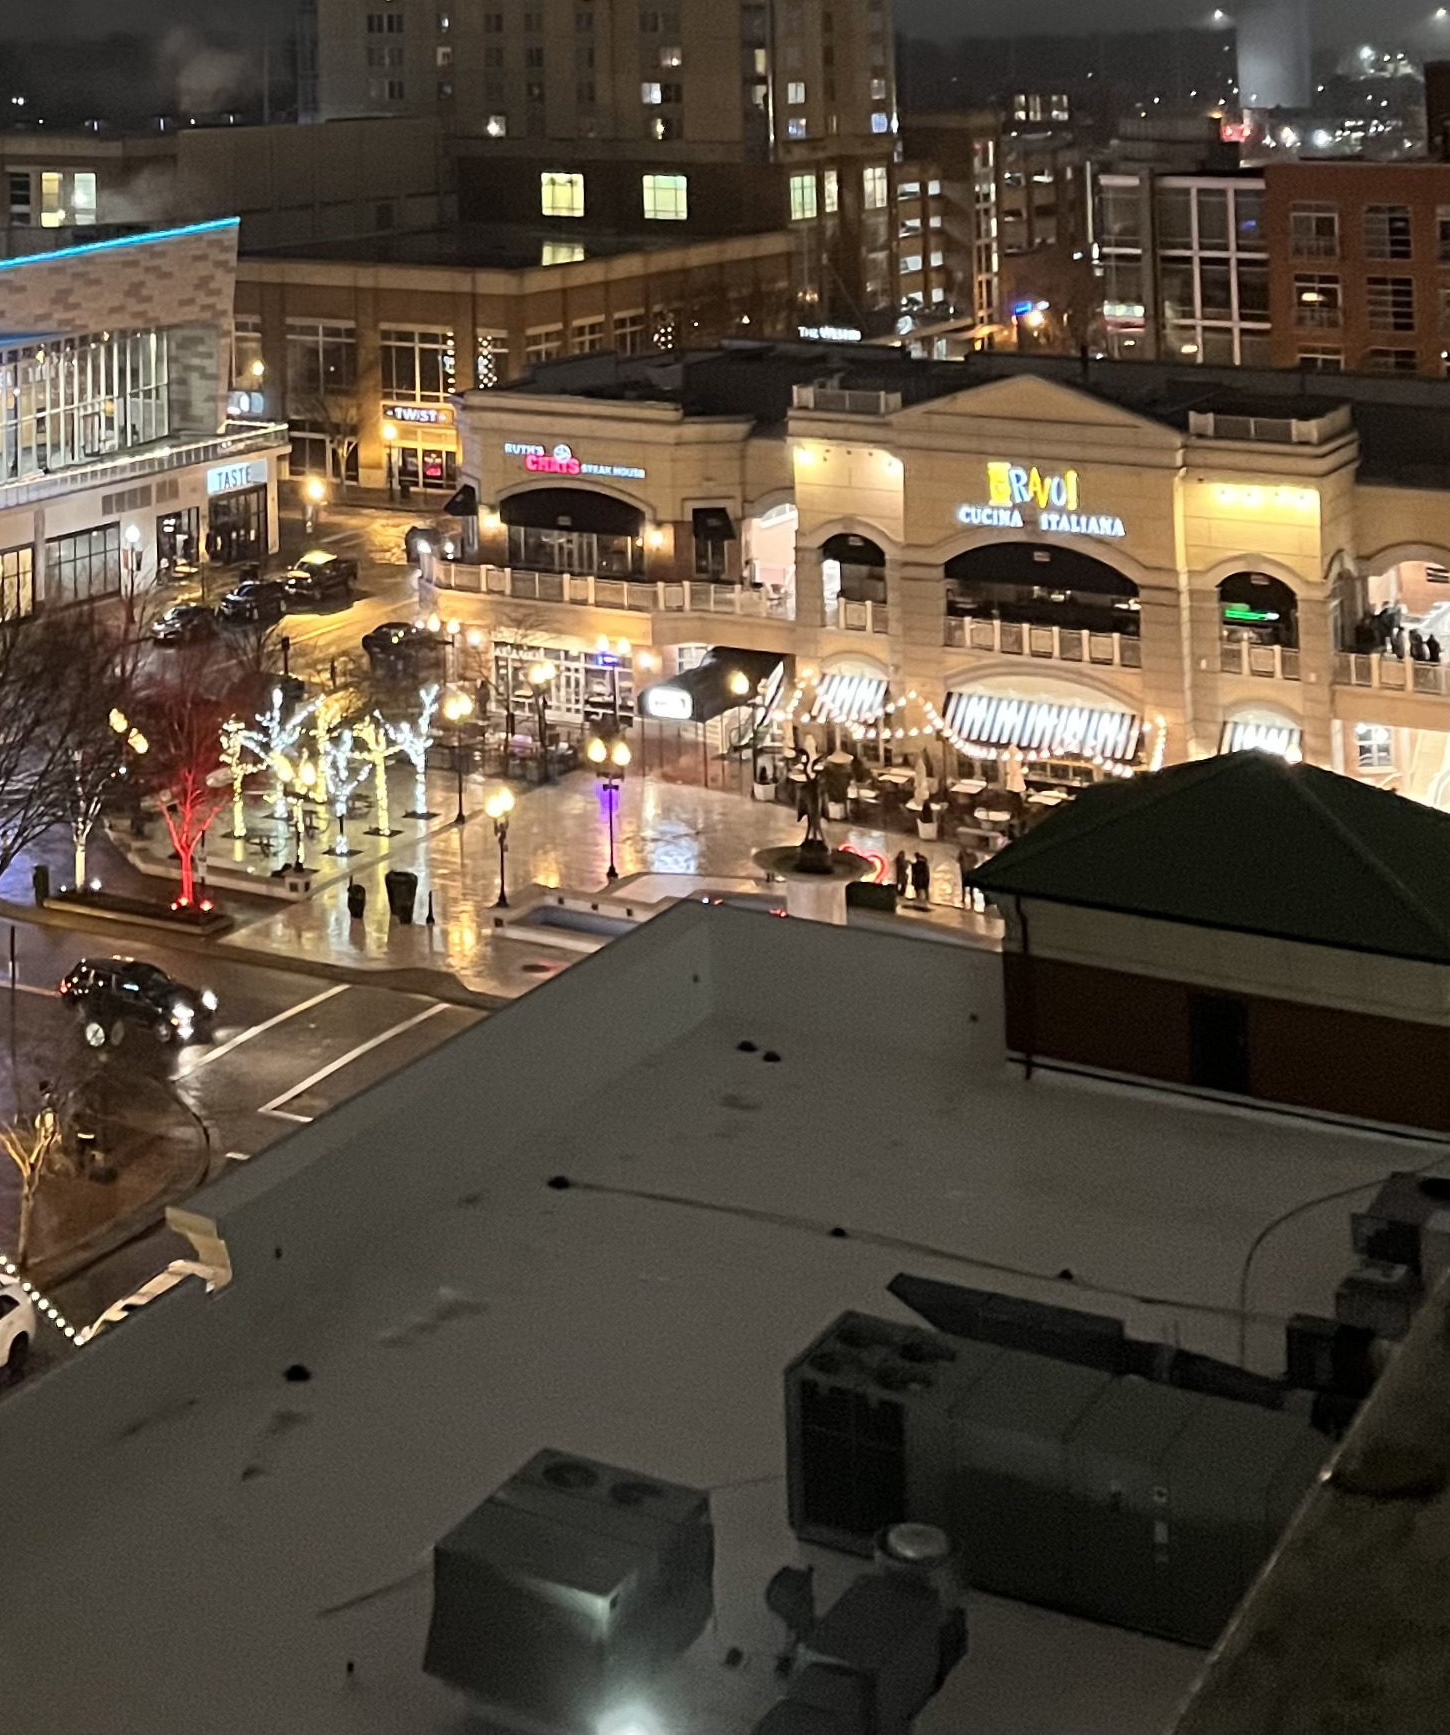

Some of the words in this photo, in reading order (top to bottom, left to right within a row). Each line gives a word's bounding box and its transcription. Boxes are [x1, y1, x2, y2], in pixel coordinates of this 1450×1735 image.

[394, 407, 438, 423] TWIST
[504, 442, 546, 457] RUTH'S
[217, 465, 252, 489] TASTE
[581, 463, 612, 476] STEAK
[612, 466, 646, 479] HOUSE
[958, 505, 1024, 528] CUCINA
[1039, 512, 1127, 538] ITALIANA
